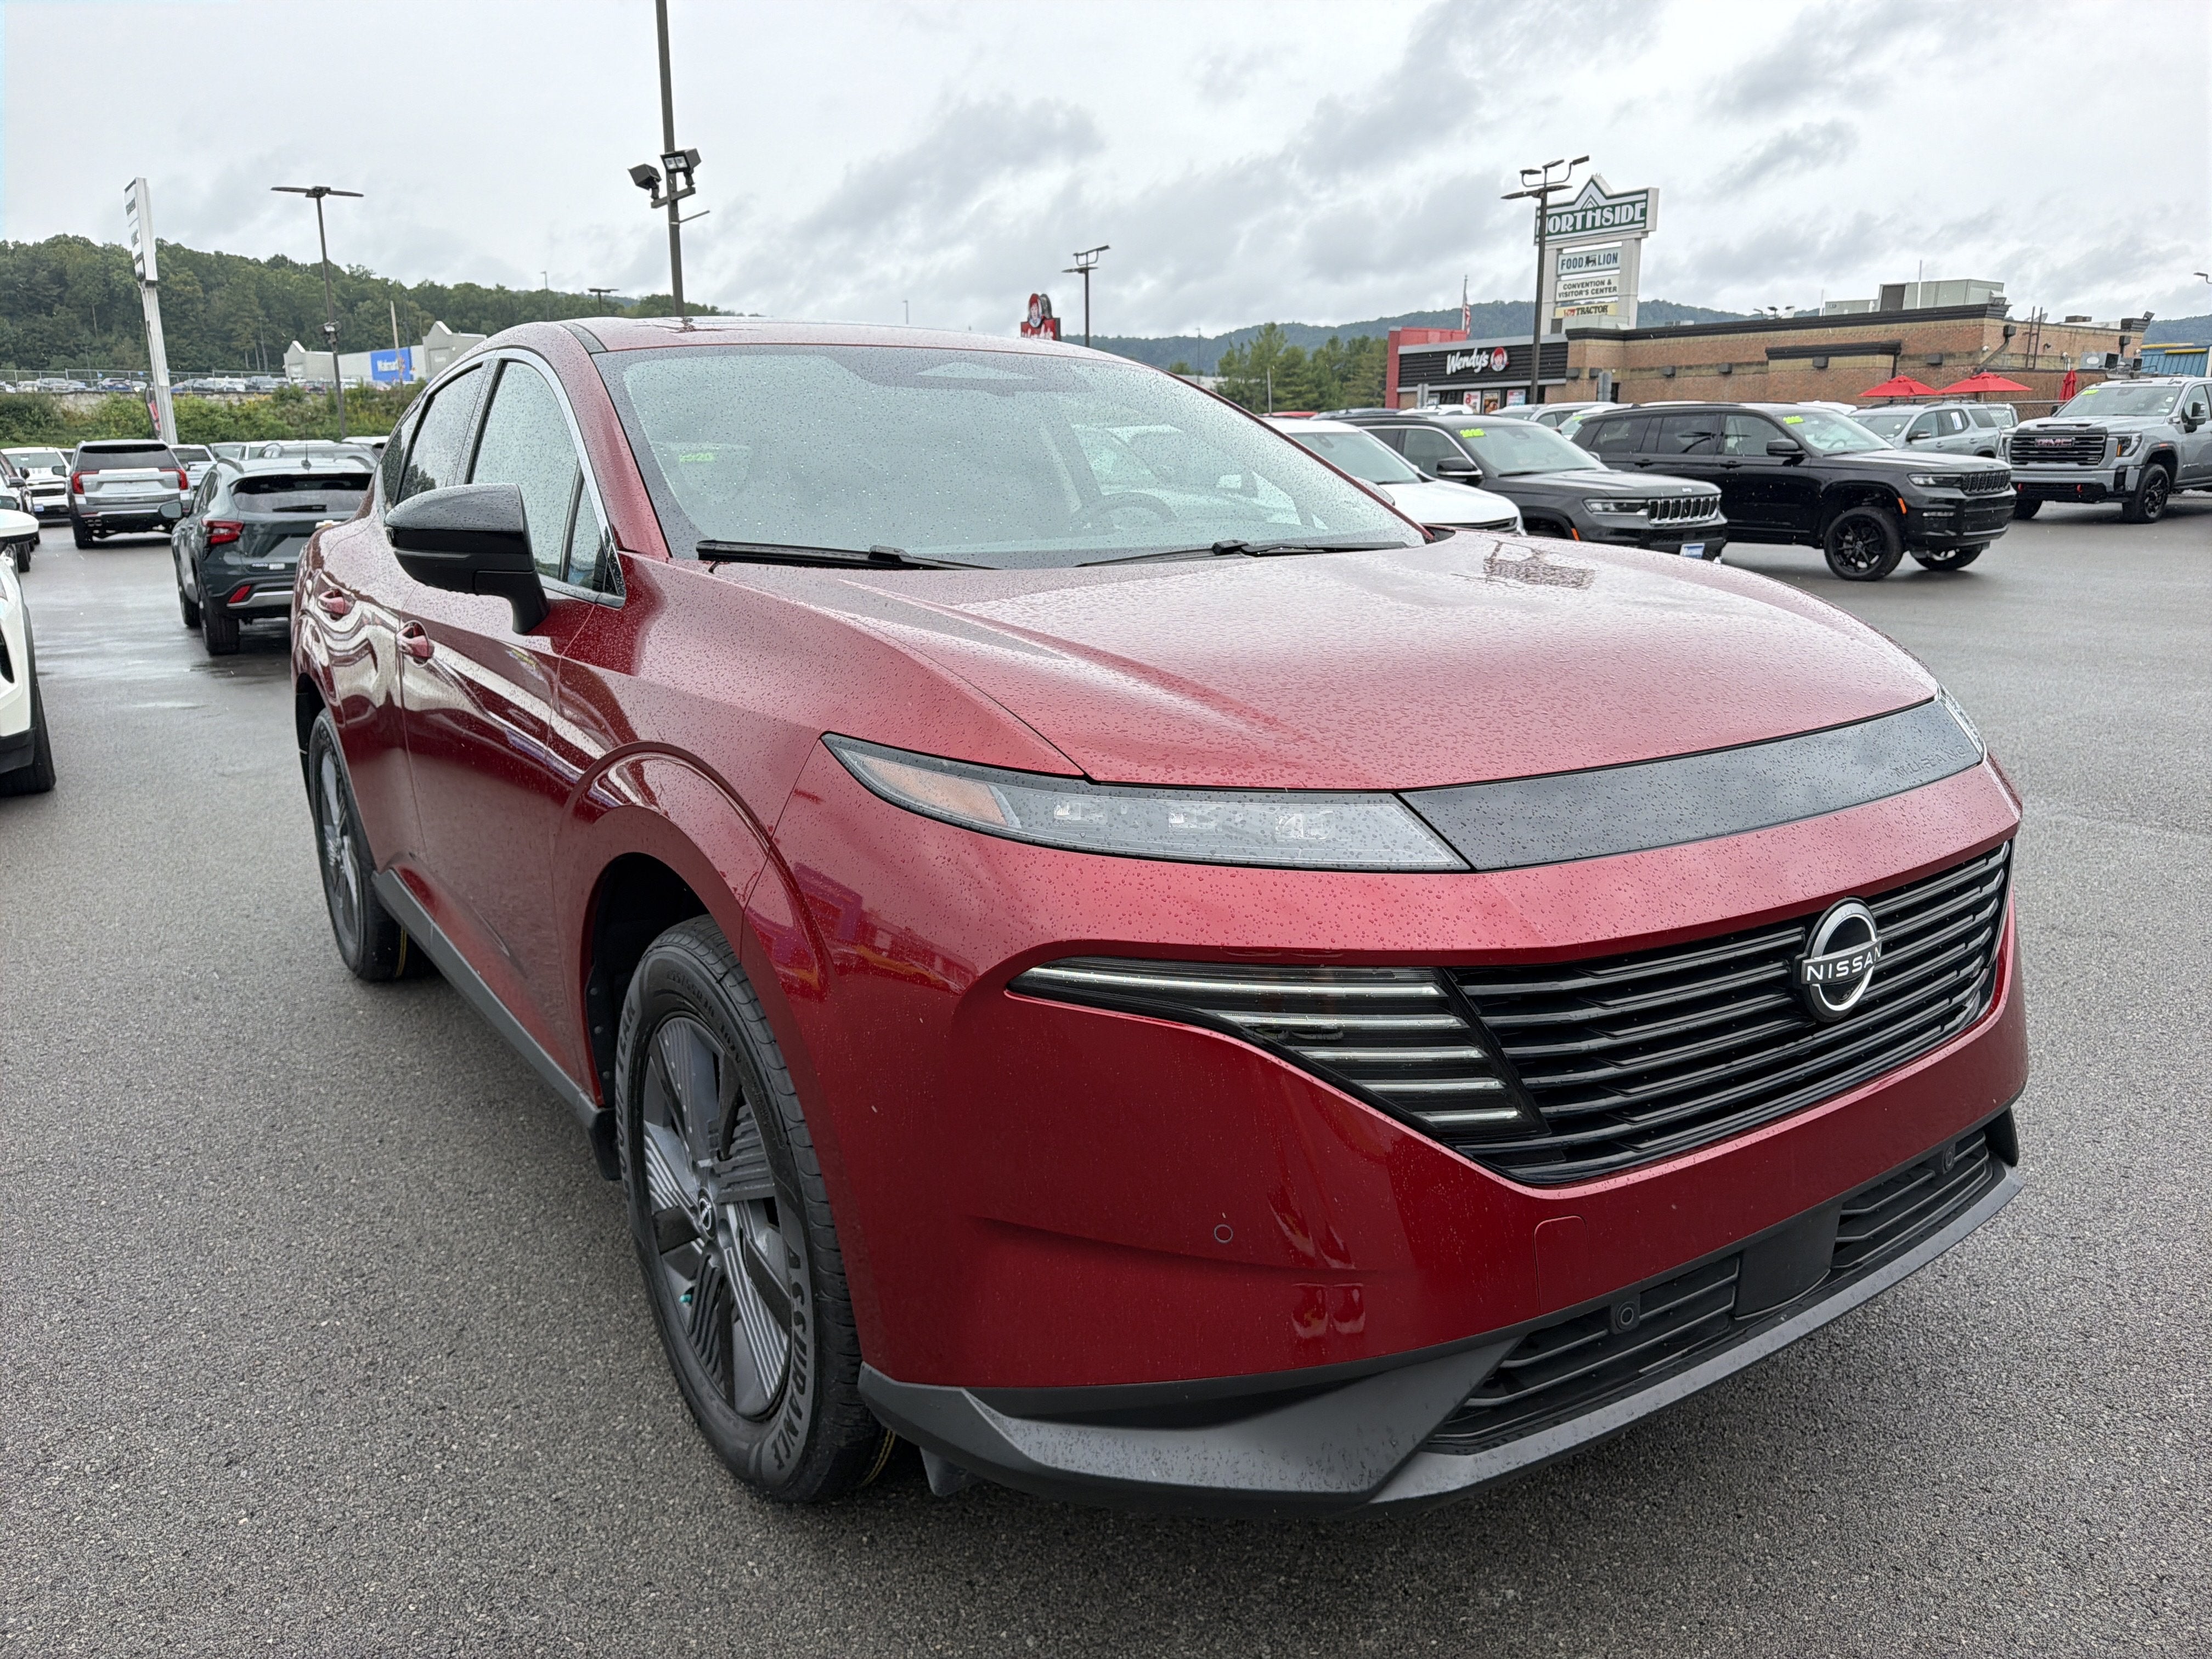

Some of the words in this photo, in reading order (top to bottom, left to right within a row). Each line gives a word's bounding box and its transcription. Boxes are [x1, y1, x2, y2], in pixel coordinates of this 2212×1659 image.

[1561, 257, 1584, 270] FOOD
[1598, 252, 1618, 266] LION
[1559, 289, 1589, 298] VISITOR'S
[1591, 286, 1617, 295] CENTER
[1563, 279, 1605, 290] CONVENTION
[1576, 305, 1609, 315] TRACTOR
[1446, 347, 1489, 375] Wendy's
[1807, 946, 1881, 981] NISSAN
[771, 1240, 807, 1471] ASSURANCE
